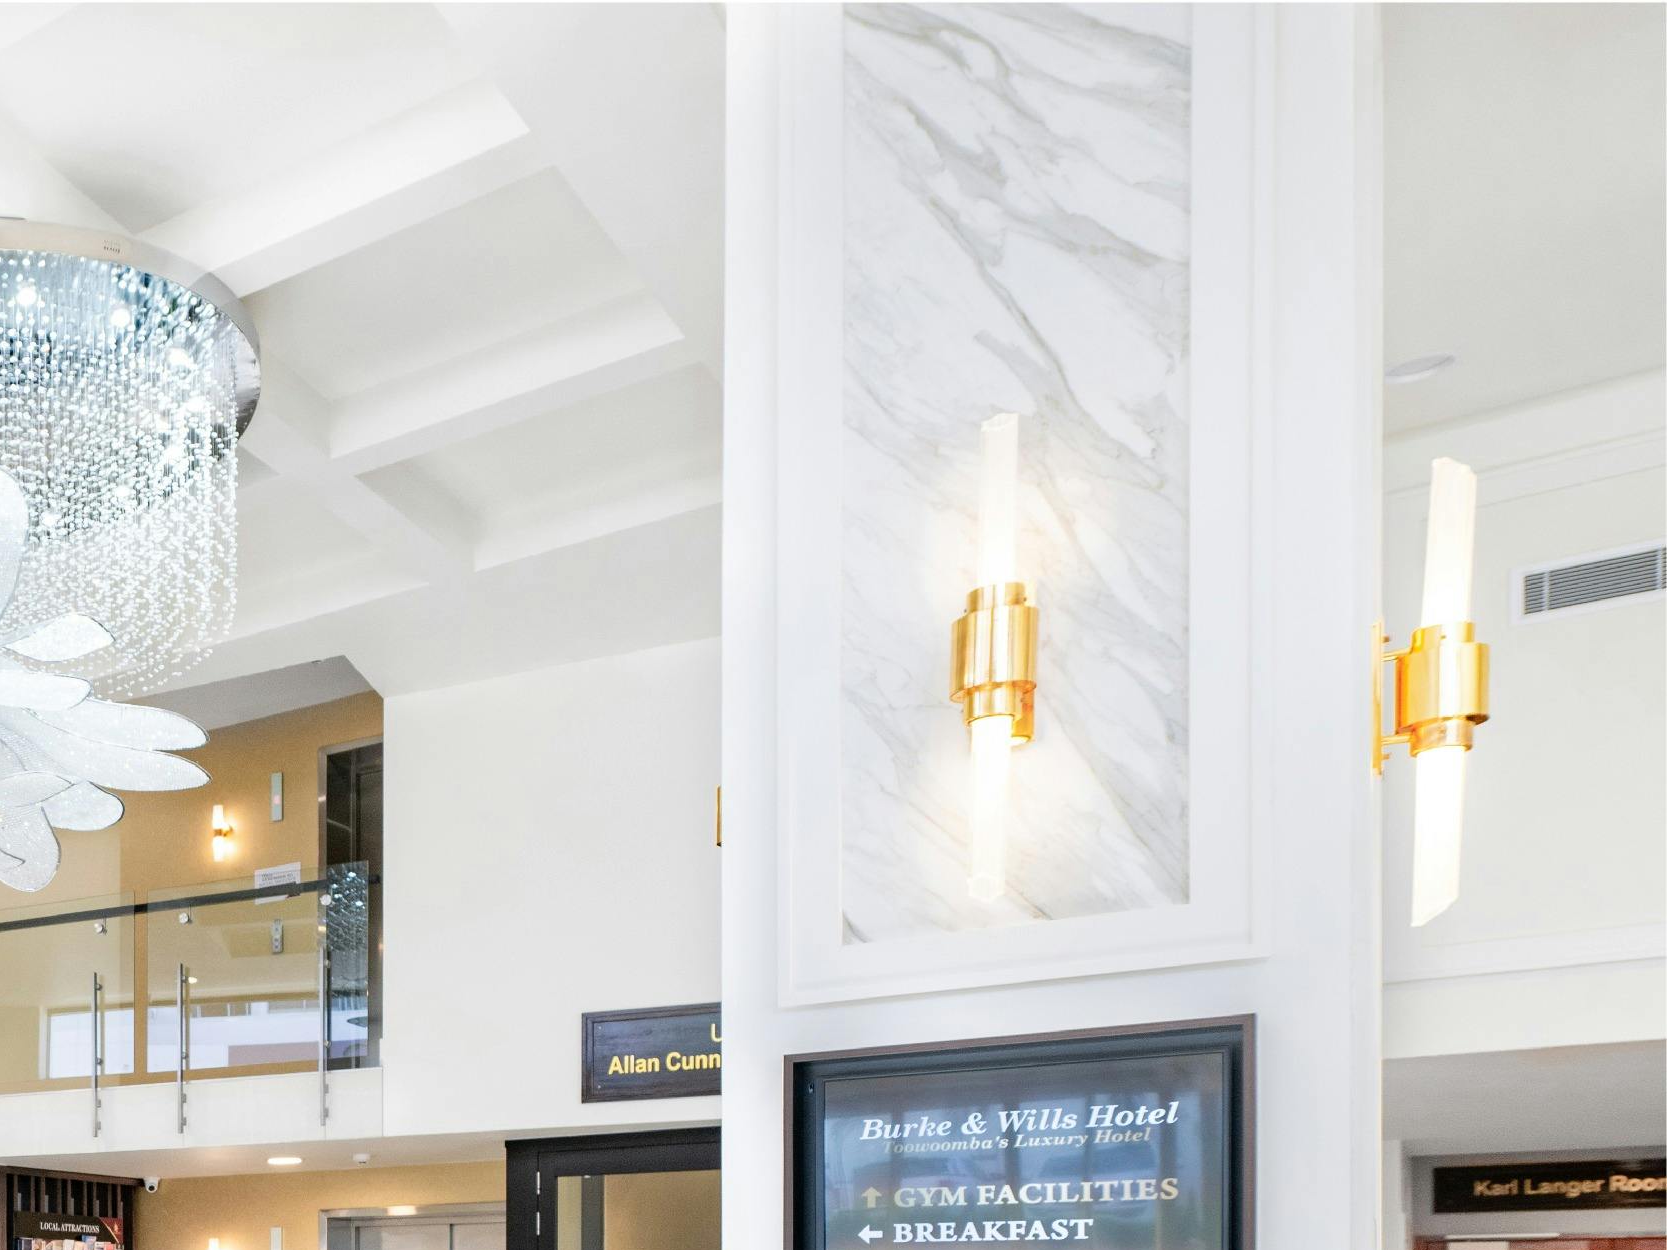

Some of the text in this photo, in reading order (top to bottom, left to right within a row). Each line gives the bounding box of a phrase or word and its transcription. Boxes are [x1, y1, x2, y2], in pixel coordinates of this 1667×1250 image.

[608, 1051, 721, 1075] Allan Cunn
[860, 1101, 1181, 1142] Burke & Wills Hotel
[883, 1126, 1152, 1156] Toowoomba's Luxury Hotel
[894, 1177, 1180, 1209] GYM FACILITIES
[1473, 1178, 1518, 1197] Karl
[1524, 1177, 1605, 1198] Langer
[40, 1221, 100, 1233] LOCAL ATTRACTIONS
[893, 1218, 1094, 1244] BREAKFAST
